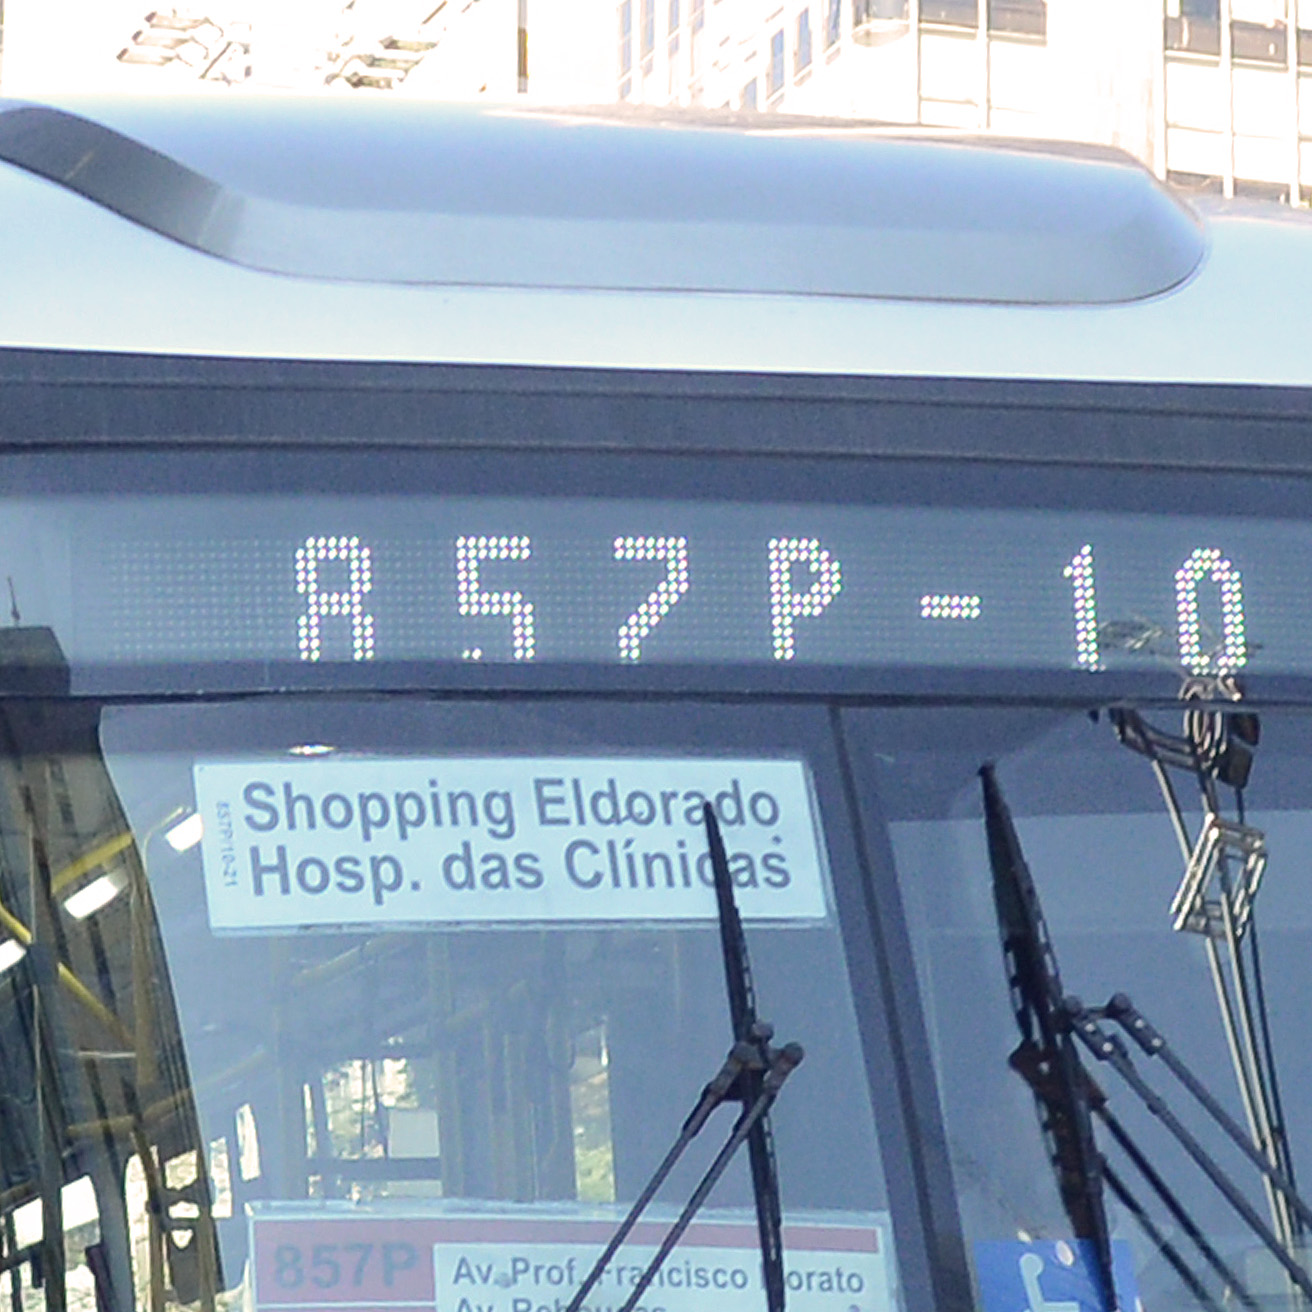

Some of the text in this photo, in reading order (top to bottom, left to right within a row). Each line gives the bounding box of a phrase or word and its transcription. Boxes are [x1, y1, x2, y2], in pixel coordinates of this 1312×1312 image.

[242, 778, 780, 841] Shopping Eldorado
[249, 838, 792, 906] Hosp. das Clínicas
[273, 1241, 419, 1291] 857P
[761, 1261, 865, 1294] orato
